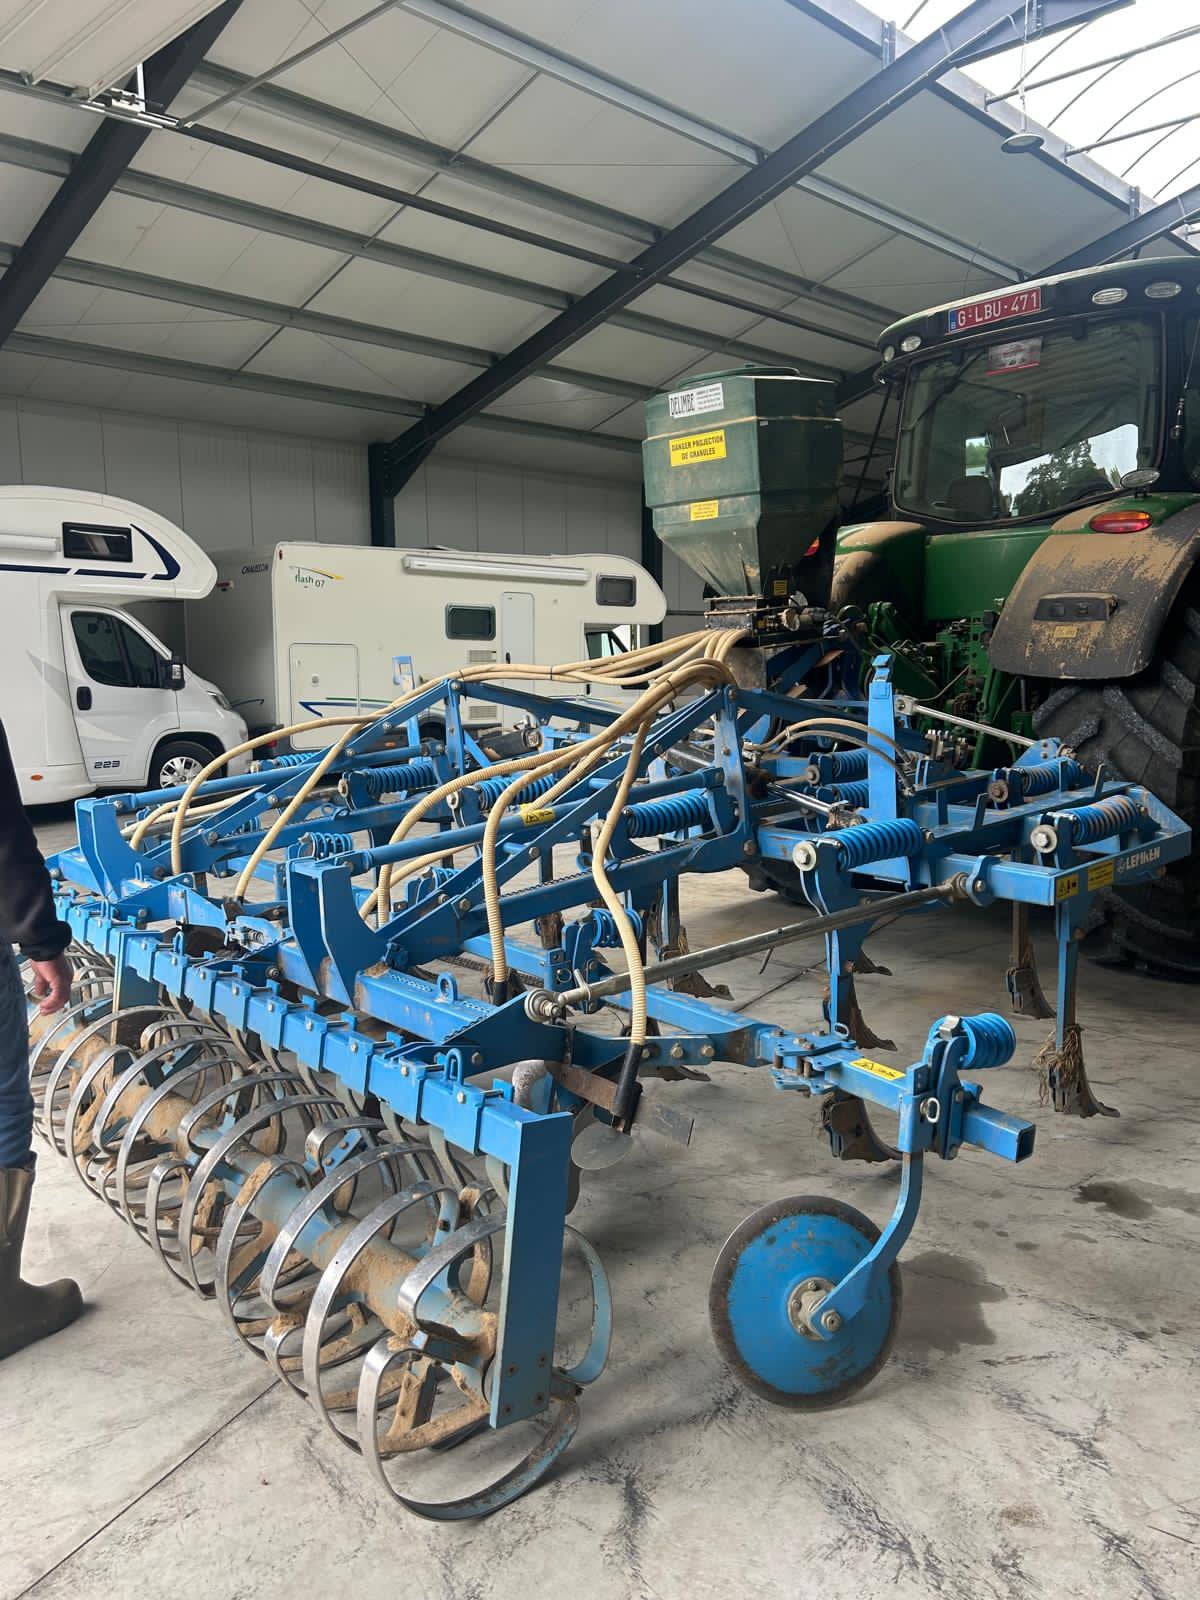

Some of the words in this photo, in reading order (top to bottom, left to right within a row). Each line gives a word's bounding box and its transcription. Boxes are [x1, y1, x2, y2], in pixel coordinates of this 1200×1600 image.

[670, 393, 695, 416] DELIMBE
[672, 441, 691, 452] DANGER
[692, 435, 723, 447] PROJECTION
[681, 452, 689, 461] DE
[690, 447, 716, 459] GRANULES
[295, 567, 314, 583] flash
[315, 579, 325, 588] 07
[94, 760, 121, 769] 223
